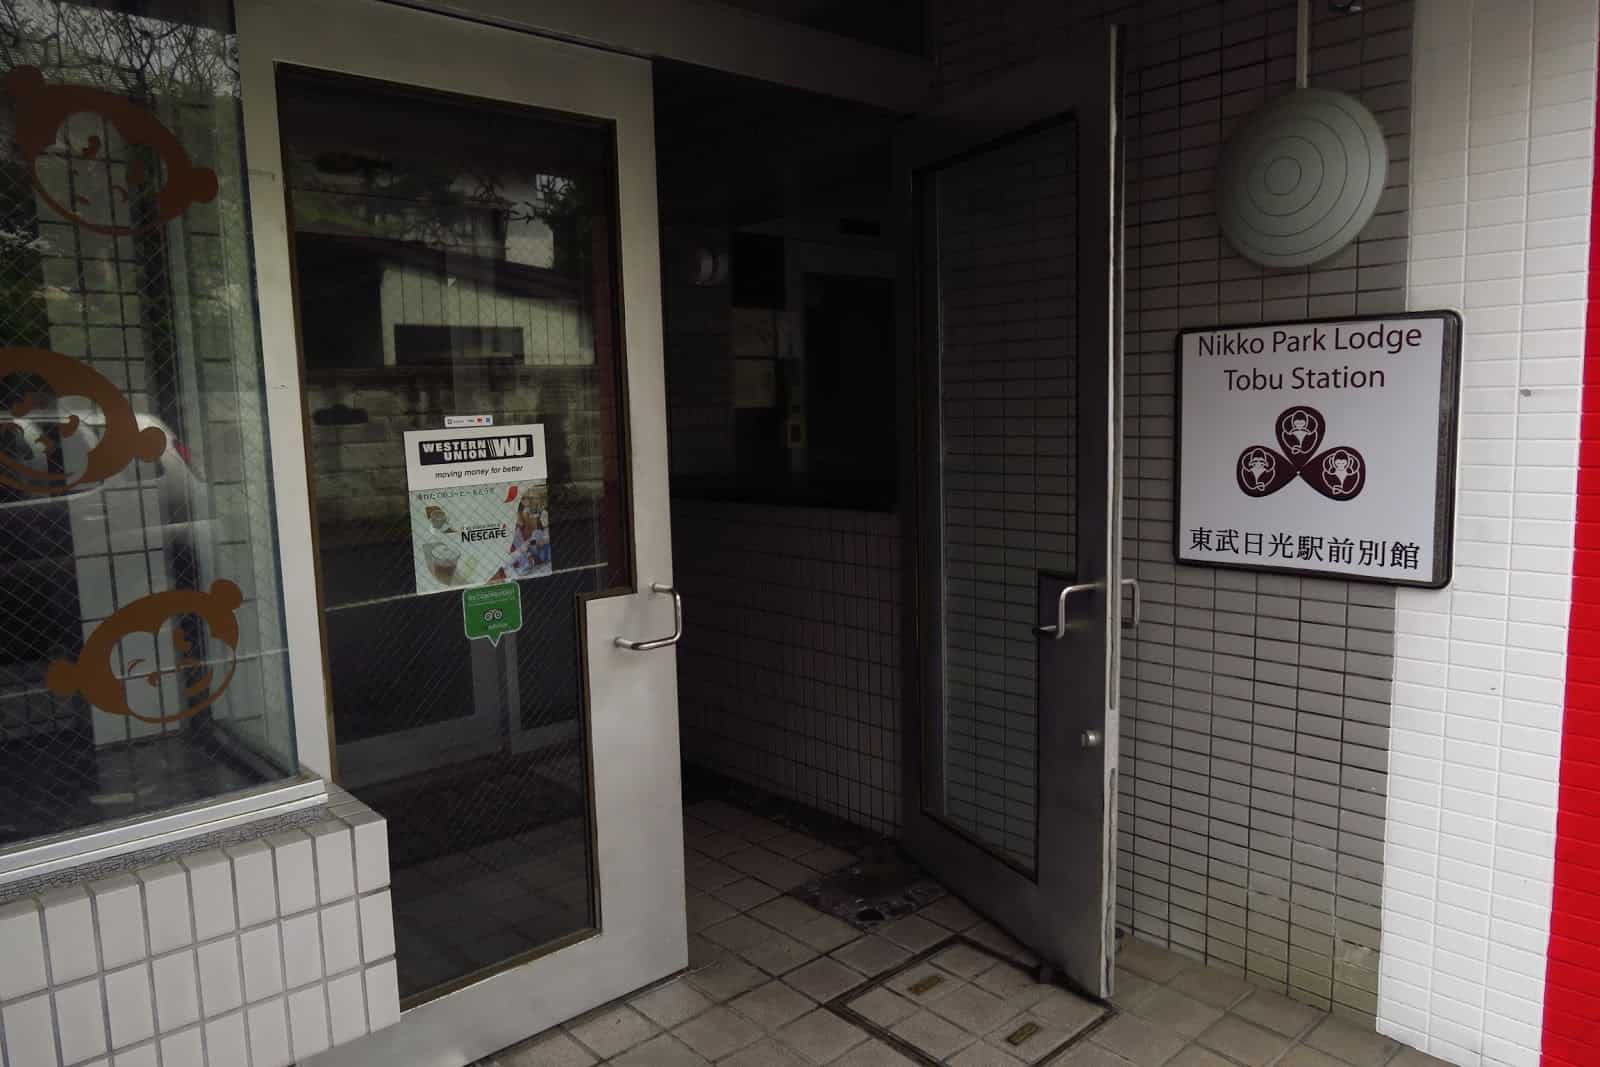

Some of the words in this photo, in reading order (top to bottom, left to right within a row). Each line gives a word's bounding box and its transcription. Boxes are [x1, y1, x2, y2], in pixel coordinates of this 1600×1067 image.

[1198, 331, 1265, 357] Nikko
[1272, 327, 1327, 354] Park
[1334, 323, 1423, 355] Lodge
[1223, 367, 1284, 392] Tobu
[1291, 365, 1386, 391] Station
[422, 440, 487, 454] WESTERN
[494, 437, 528, 457] WU
[443, 450, 487, 462] UNION
[434, 471, 463, 479] moving
[464, 468, 490, 477] money
[490, 466, 502, 474] for
[502, 464, 525, 473] better
[1188, 526, 1421, 571] 東武日光駅前別館
